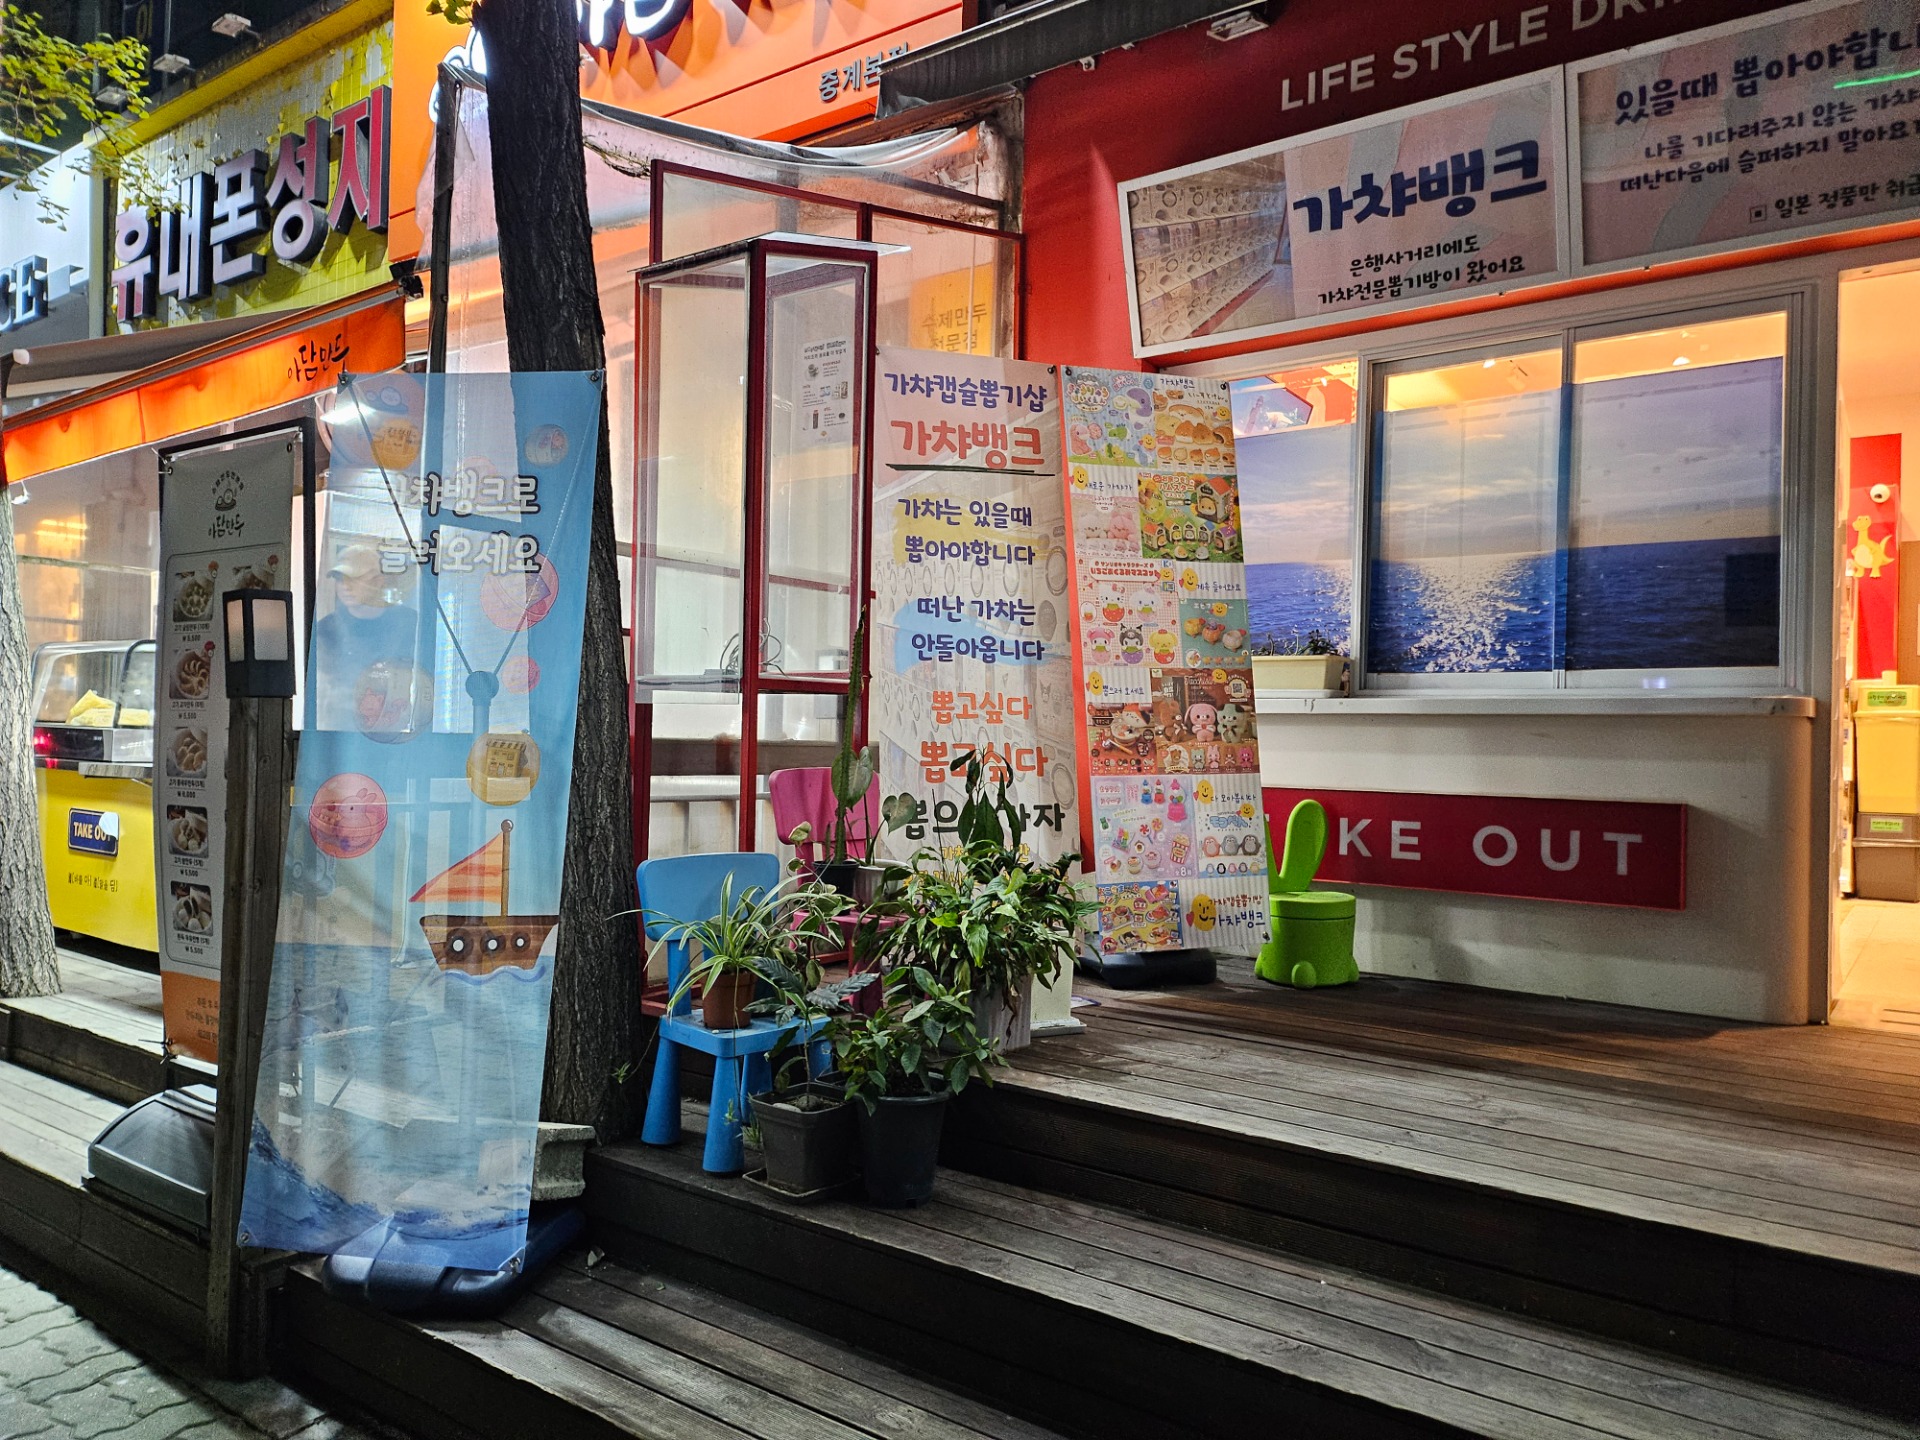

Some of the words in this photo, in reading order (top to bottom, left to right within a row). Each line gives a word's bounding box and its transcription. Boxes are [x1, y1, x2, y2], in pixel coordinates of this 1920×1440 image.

[1281, 54, 1376, 111] LIFE
[1393, 5, 1549, 79] STYLE
[1615, 72, 1718, 125] 있을때
[1644, 134, 1684, 160] 나를
[1692, 112, 1804, 149] 기다려주지
[1811, 101, 1857, 127] 않는
[1620, 157, 1730, 192] 떠난다음에
[1738, 136, 1829, 174] 슬퍼하지
[1293, 140, 1547, 233] 가챠뱅크
[1775, 192, 1812, 219] 일본
[1819, 182, 1879, 209] 정품만
[1350, 235, 1481, 277] 은행사거리에도
[1318, 267, 1461, 305] 가챠전문뽑기방이
[1467, 255, 1526, 284] 왔어요
[921, 303, 988, 329] 수제만두
[287, 333, 350, 383] 아담만두
[884, 373, 1048, 413] 가챠캡슐뽑기샵
[890, 420, 1045, 469] 가챠뱅크
[208, 513, 245, 539] 아담만두
[898, 498, 962, 525] 가챠는
[969, 501, 1032, 528] 있을때
[905, 535, 1036, 567] 뽑아야합니다
[917, 595, 964, 623] 떠난
[971, 598, 1036, 626] 가챠는
[911, 633, 1045, 664] 안돌아옵니다
[931, 690, 1033, 725] 뽑고싶다
[919, 740, 1049, 784] 뽑고싶다
[73, 821, 93, 840] TAKE
[1472, 824, 1644, 877] OUT
[1209, 910, 1266, 929] 가챠뱅크
